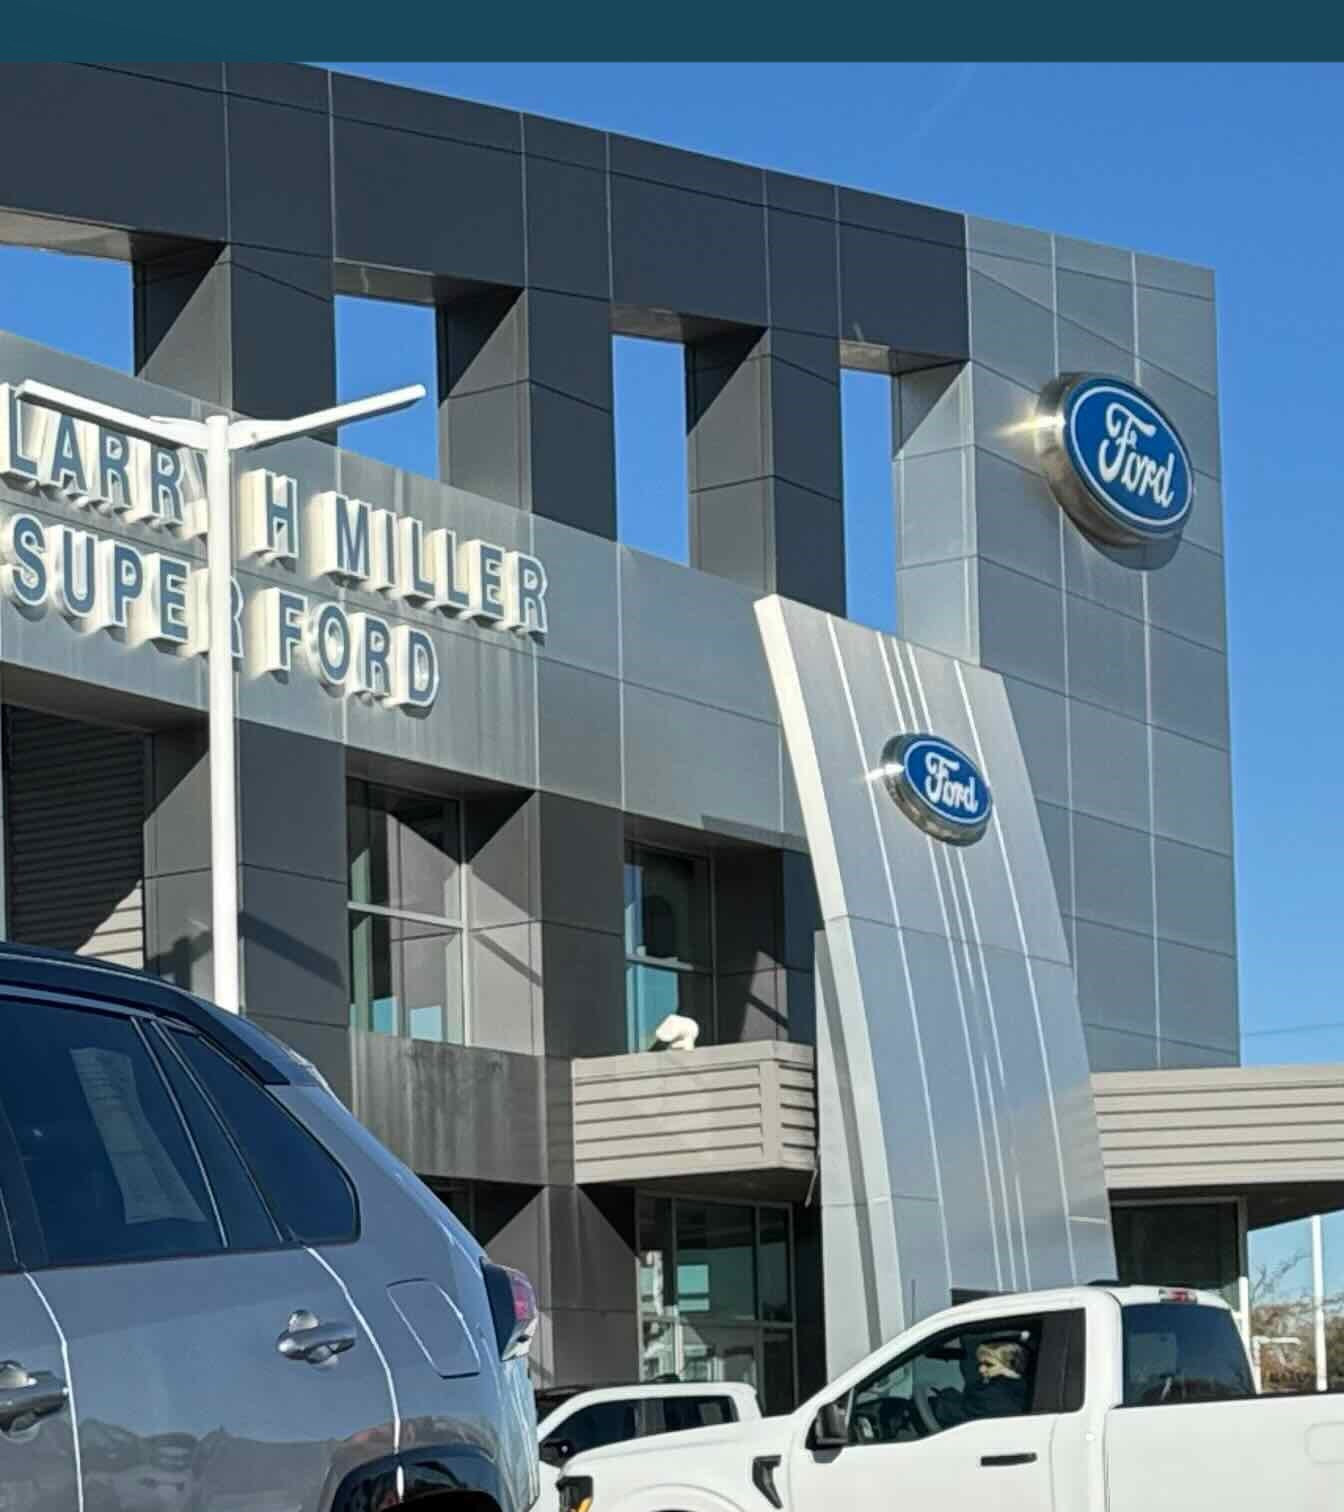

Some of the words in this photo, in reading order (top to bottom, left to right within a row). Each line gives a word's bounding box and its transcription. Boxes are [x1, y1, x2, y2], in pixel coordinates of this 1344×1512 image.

[1097, 401, 1176, 508] Ford
[252, 467, 300, 560] H
[324, 490, 550, 635] MILLER
[264, 585, 440, 708] FORD
[923, 751, 979, 814] Ford
